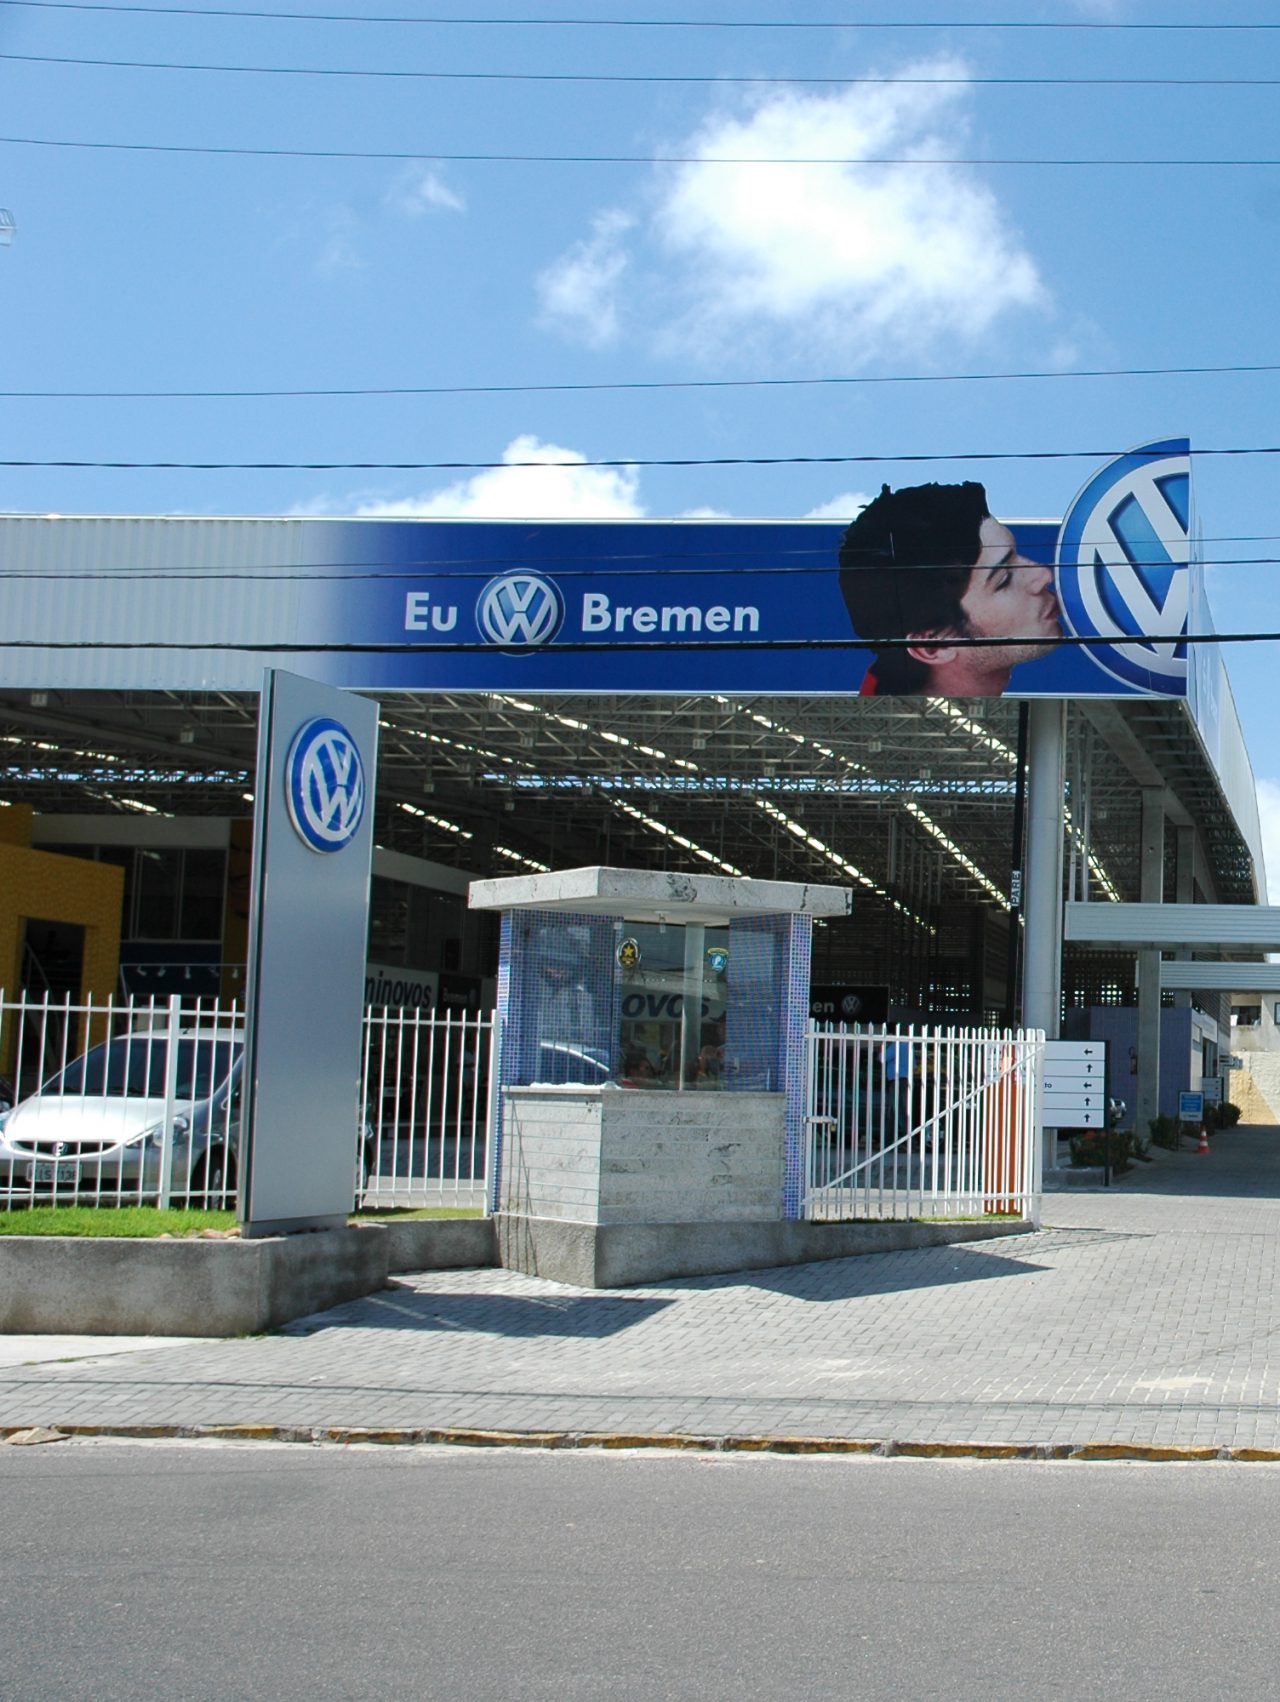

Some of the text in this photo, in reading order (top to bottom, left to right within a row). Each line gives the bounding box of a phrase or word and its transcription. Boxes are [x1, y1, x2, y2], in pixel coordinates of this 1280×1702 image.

[405, 592, 457, 631] Eu
[582, 593, 760, 632] Bremen
[365, 970, 432, 1008] minovos
